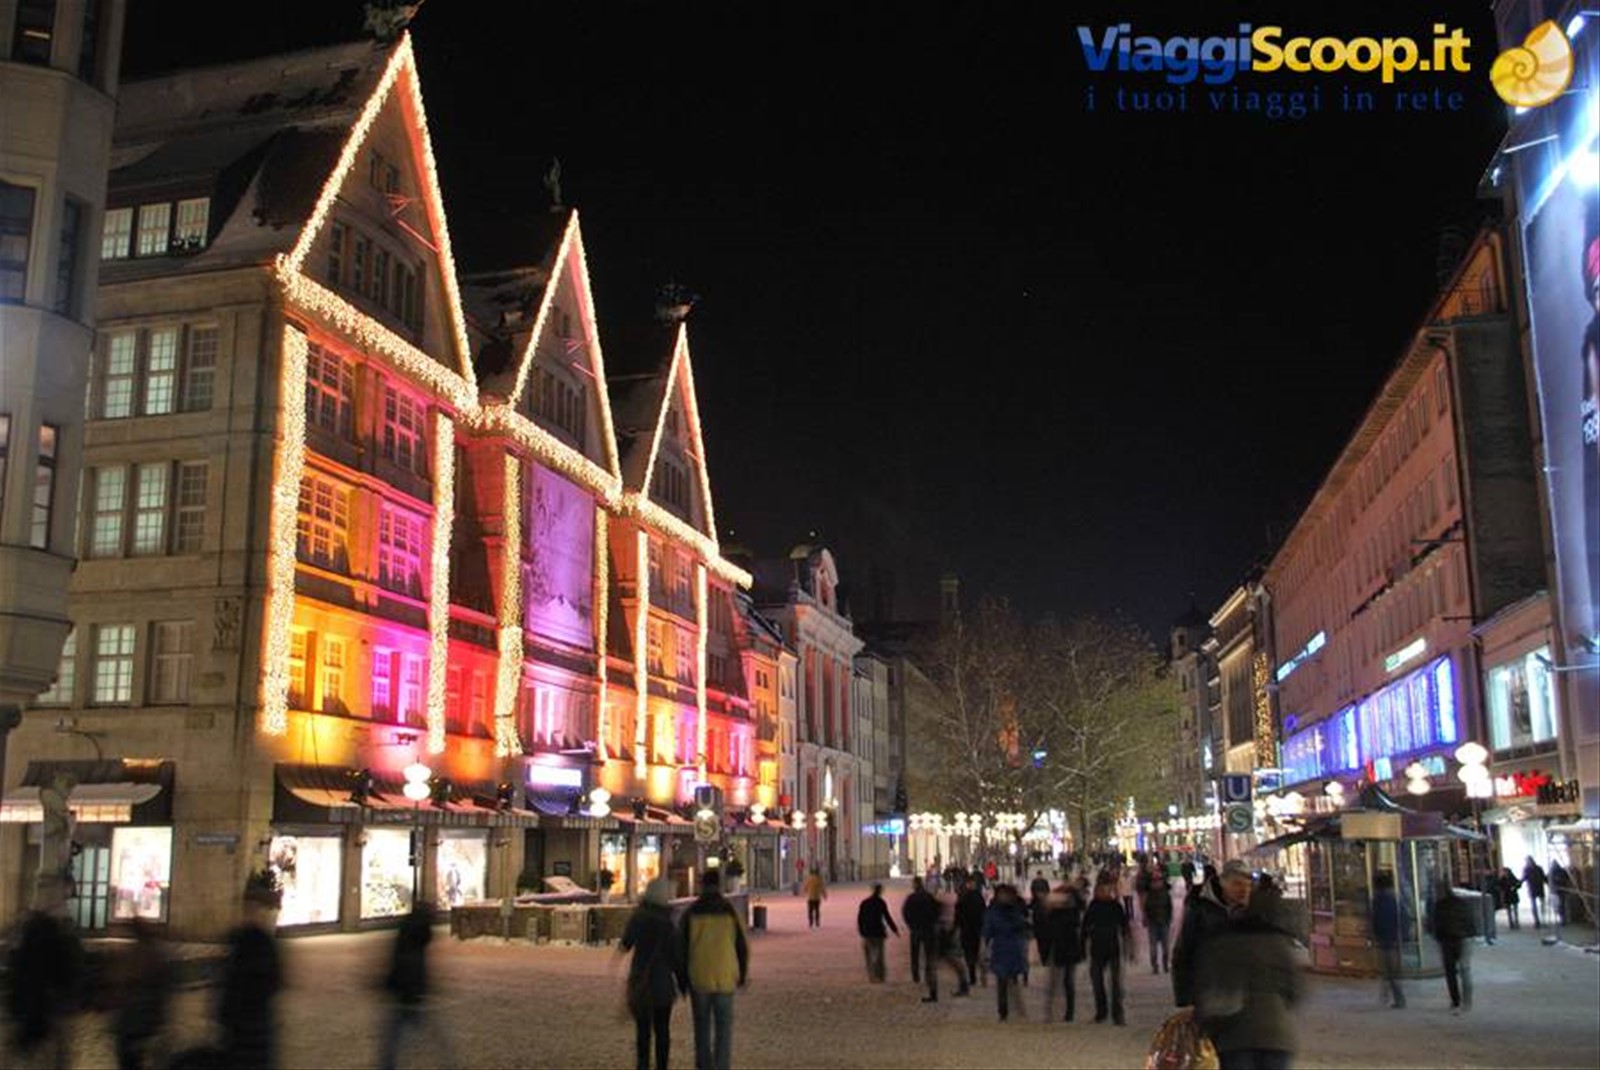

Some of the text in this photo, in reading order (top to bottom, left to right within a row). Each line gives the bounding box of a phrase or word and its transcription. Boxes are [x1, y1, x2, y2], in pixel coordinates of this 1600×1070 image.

[1227, 776, 1249, 800] U
[697, 788, 715, 810] U
[699, 820, 714, 837] S
[1232, 810, 1249, 829] S
